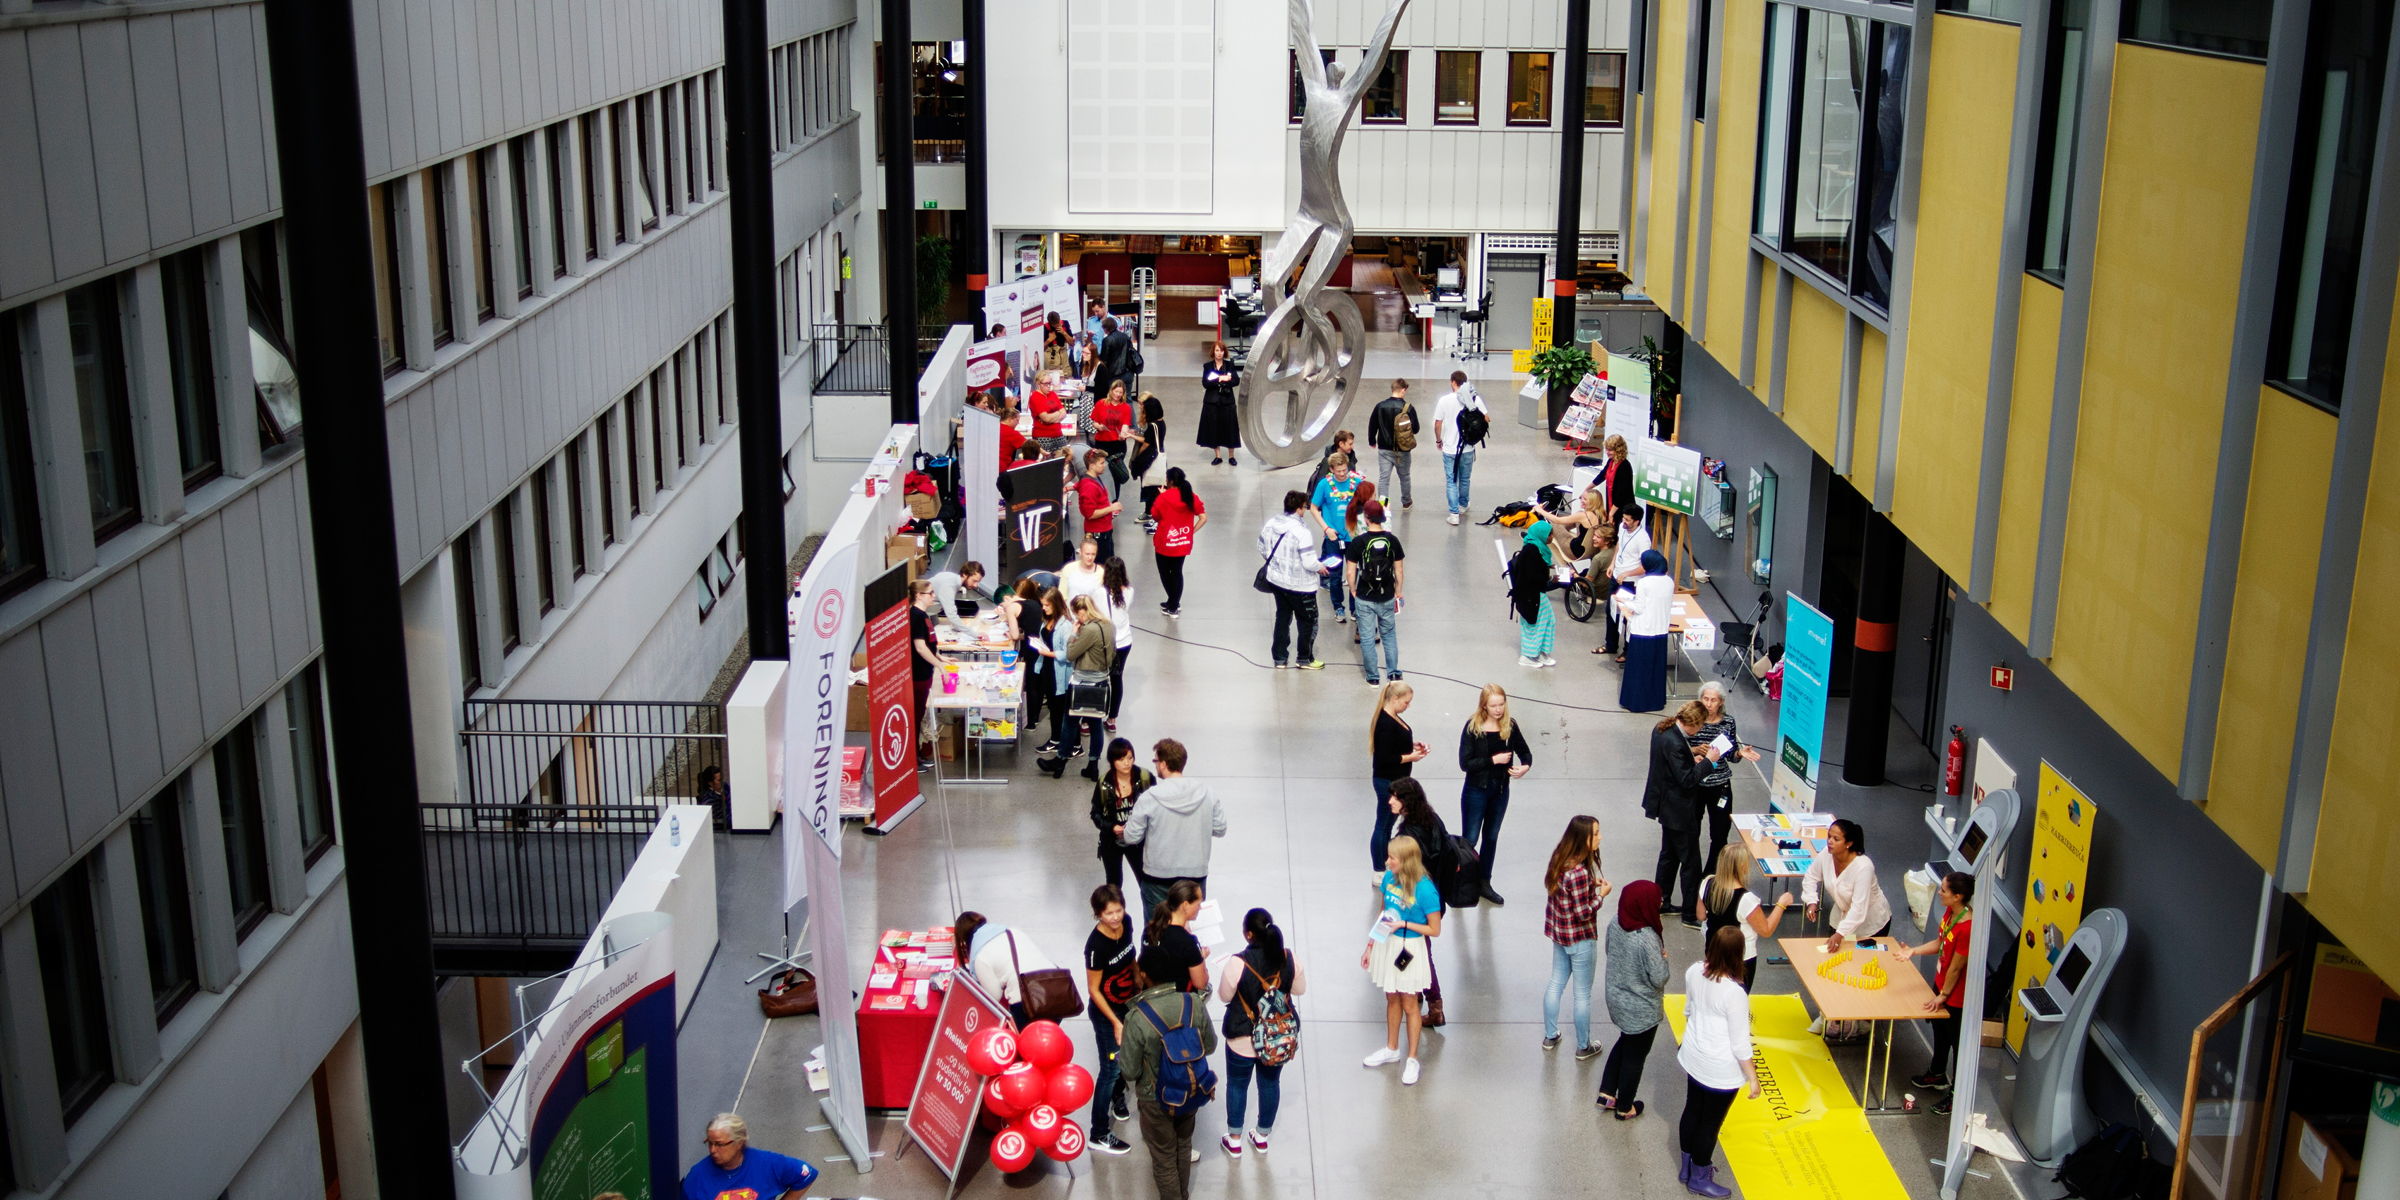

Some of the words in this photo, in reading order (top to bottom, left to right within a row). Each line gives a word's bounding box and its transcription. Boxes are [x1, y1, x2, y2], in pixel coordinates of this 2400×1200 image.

[1019, 505, 1052, 552] VT
[814, 651, 835, 840] FORENING
[944, 1026, 968, 1054] #heistud
[936, 1057, 962, 1087] studentliv
[957, 1061, 970, 1078] vinn
[936, 1070, 943, 1083] kr
[942, 1078, 952, 1092] 30
[951, 1086, 965, 1105] 000
